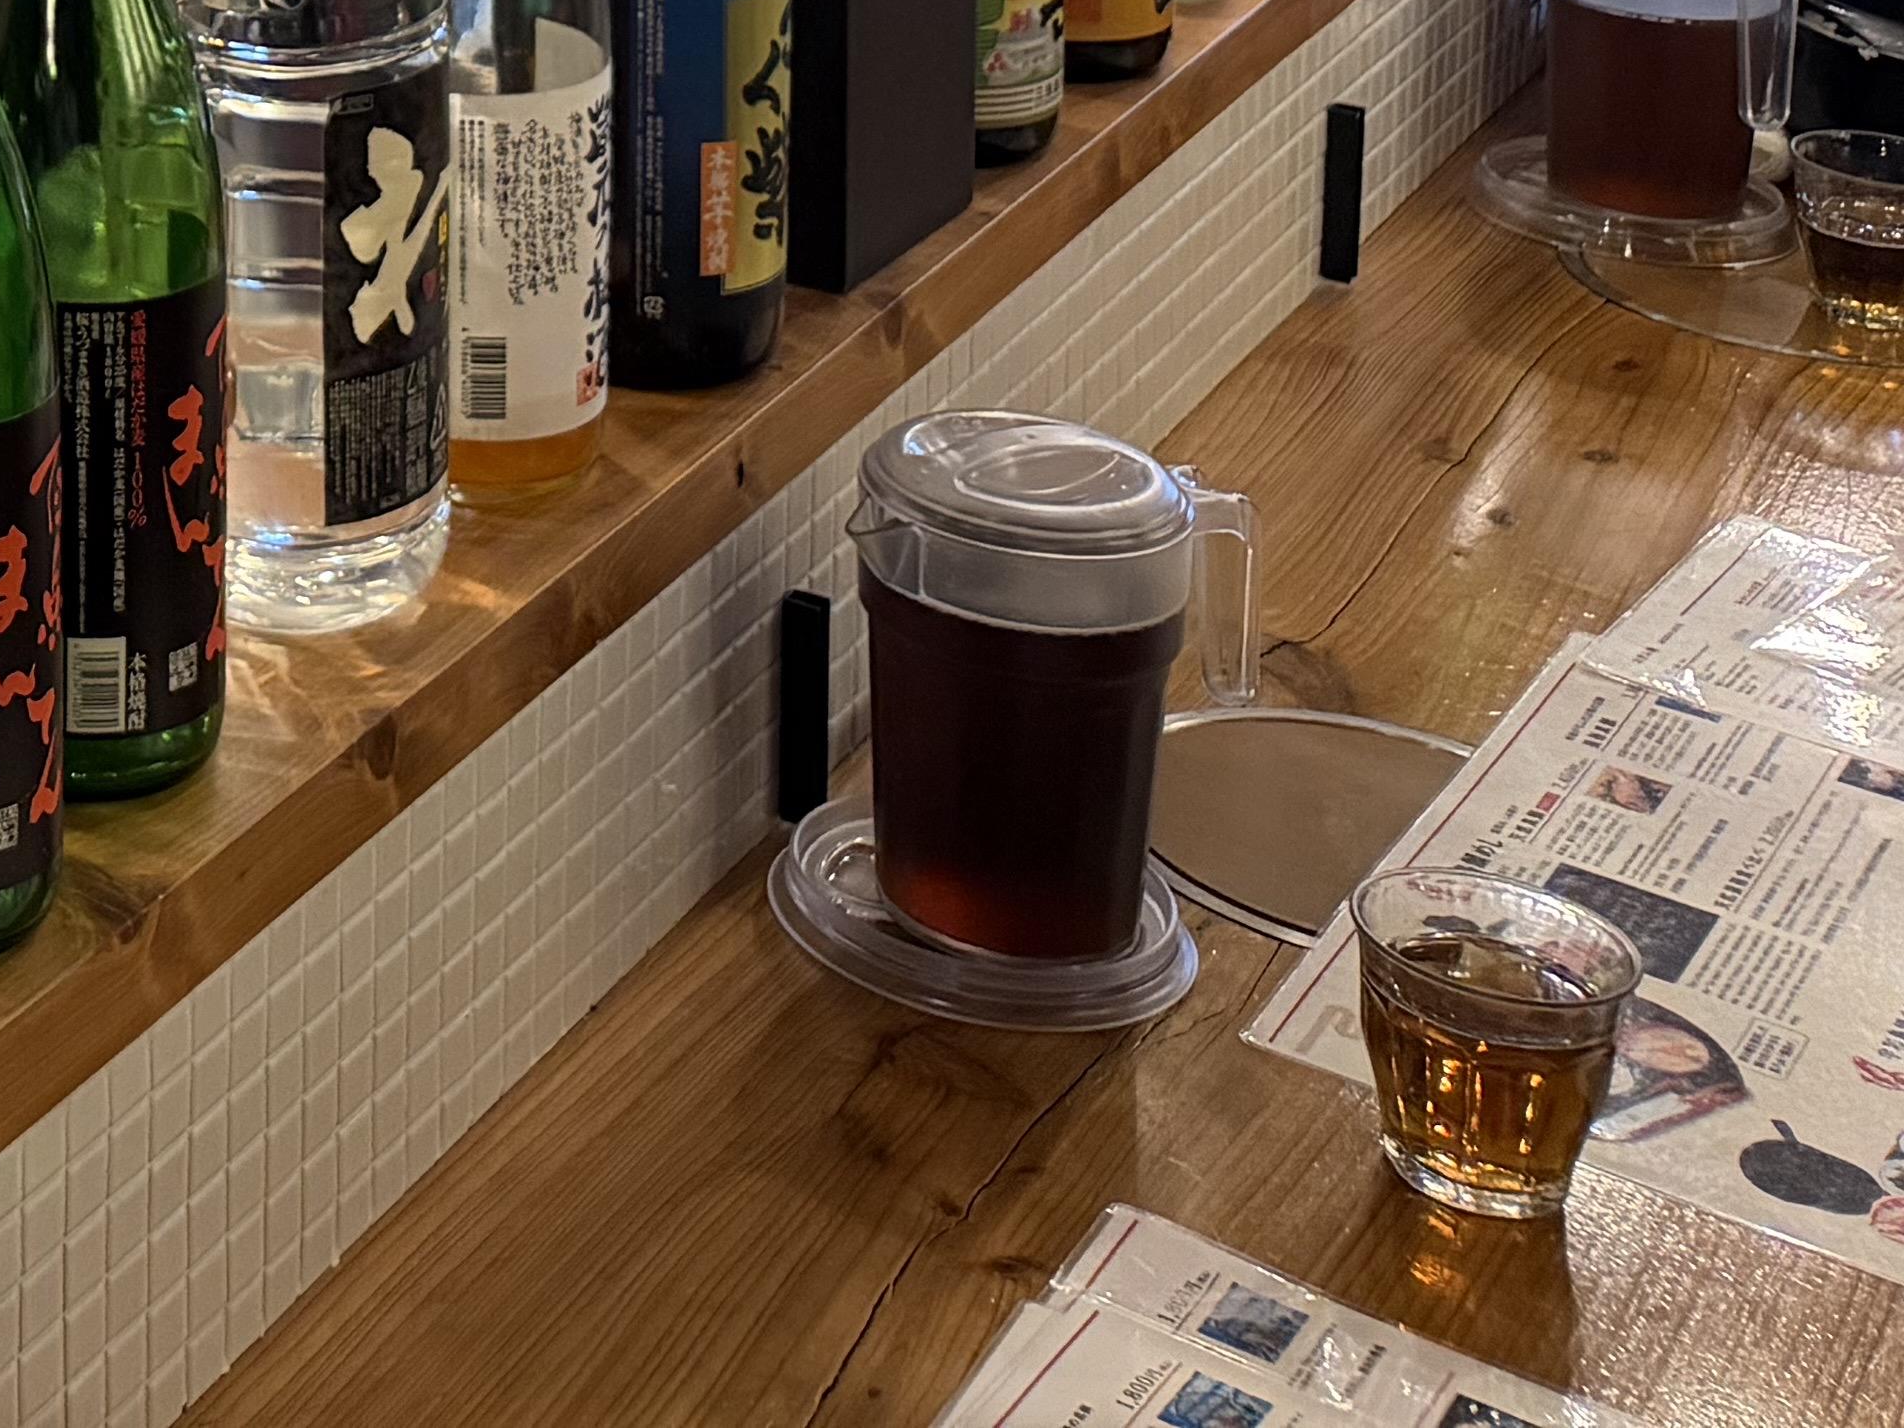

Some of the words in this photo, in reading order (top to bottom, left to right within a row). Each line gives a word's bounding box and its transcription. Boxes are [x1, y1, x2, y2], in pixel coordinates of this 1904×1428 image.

[128, 451, 147, 528] 100%
[128, 652, 146, 731] 本格焼酎
